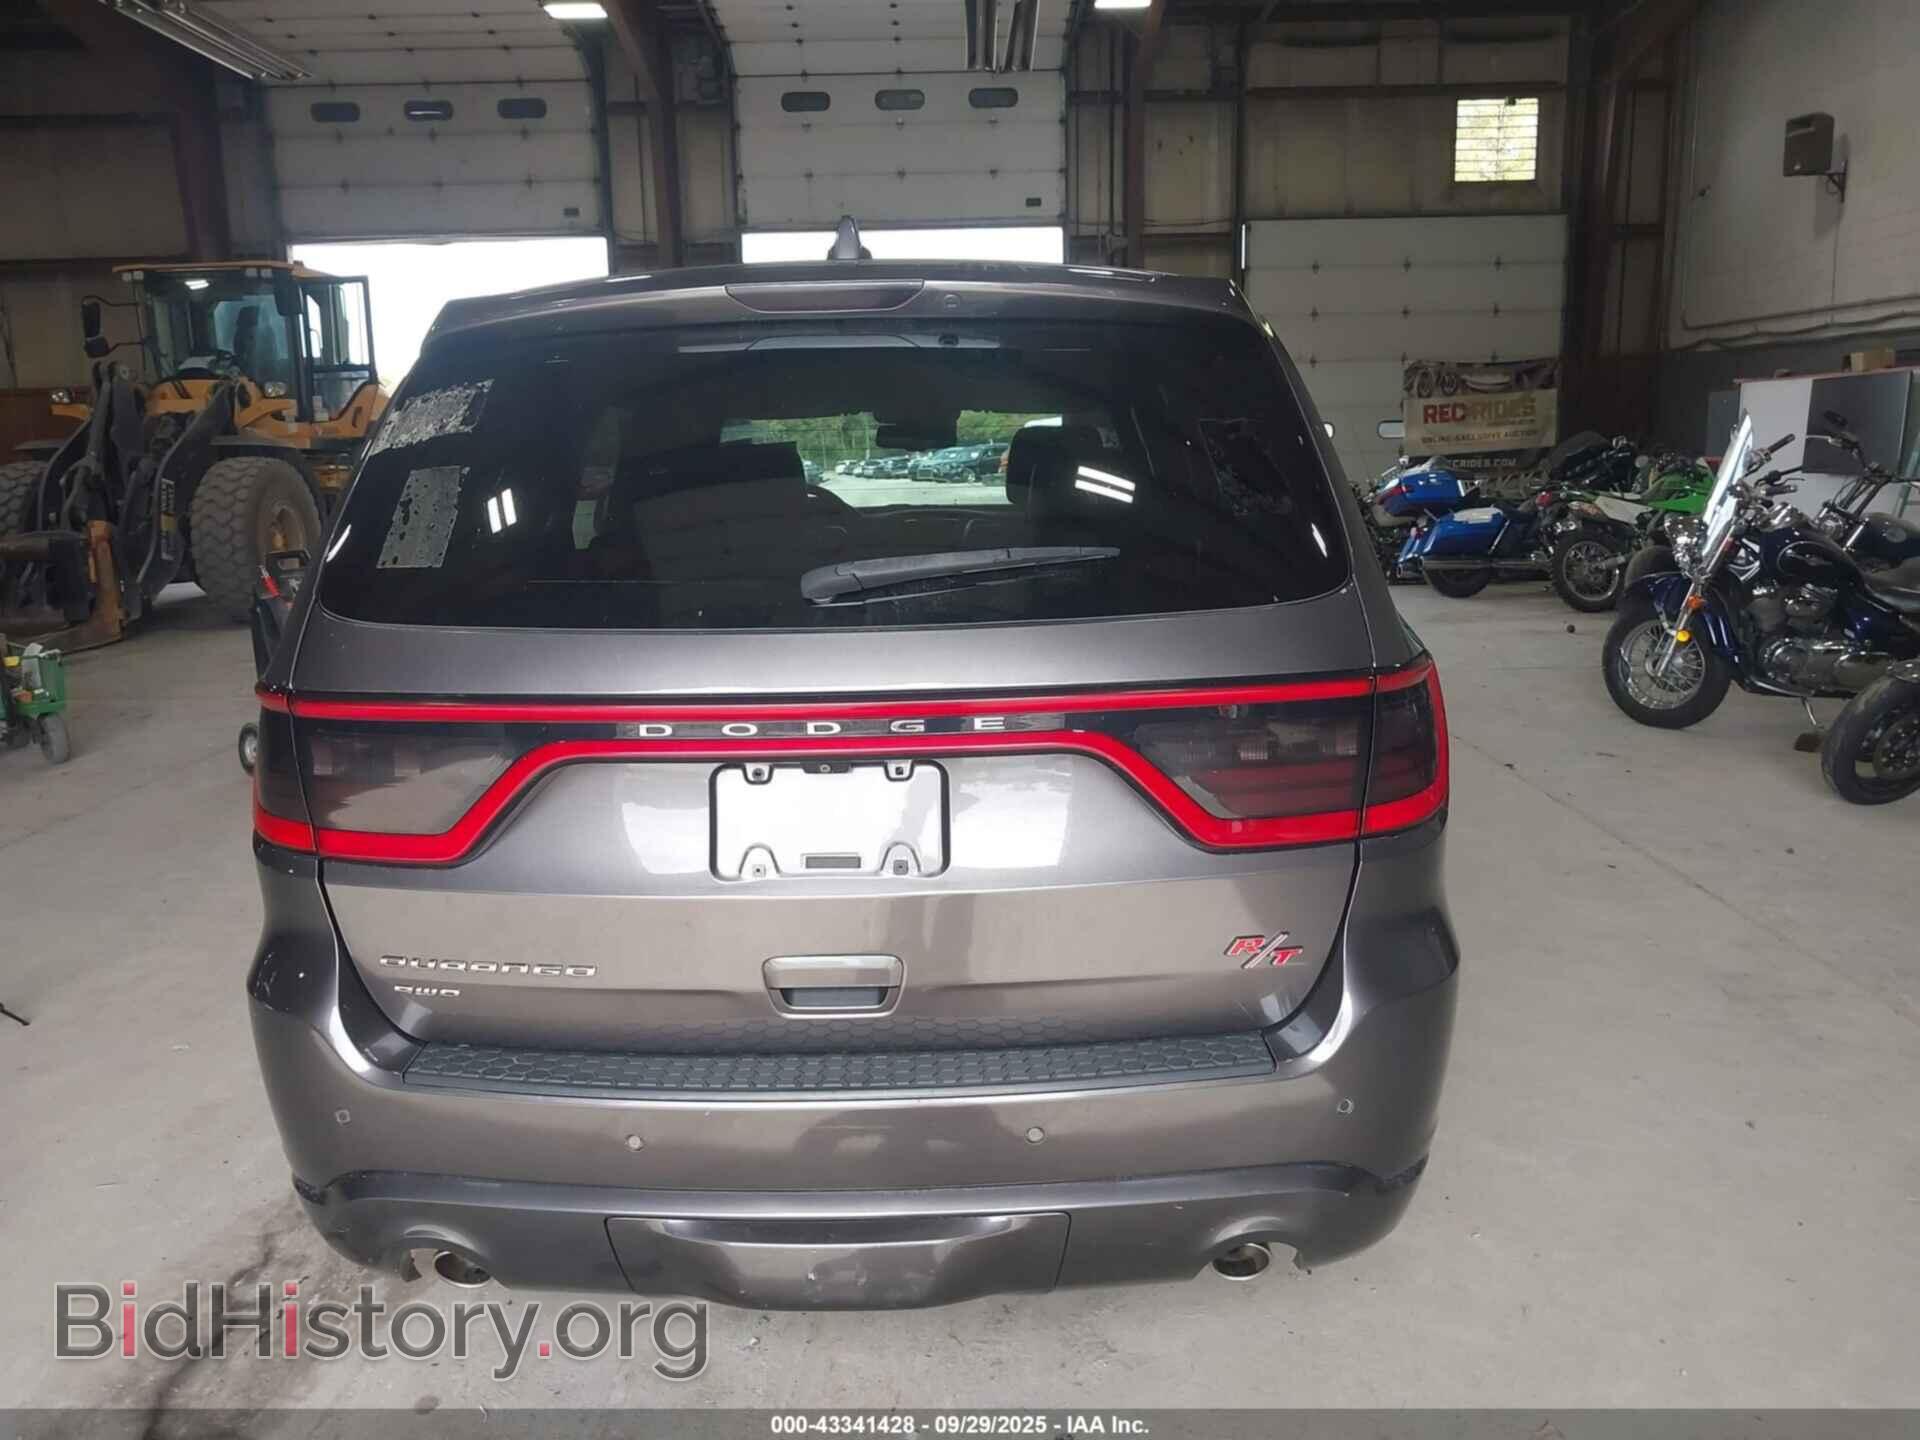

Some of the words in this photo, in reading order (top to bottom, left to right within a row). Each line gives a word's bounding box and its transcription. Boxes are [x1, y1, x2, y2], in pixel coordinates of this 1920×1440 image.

[638, 716, 1006, 738] DODGE
[1224, 931, 1304, 969] R/T
[379, 954, 598, 977] DURANGO
[394, 984, 461, 998] AWD
